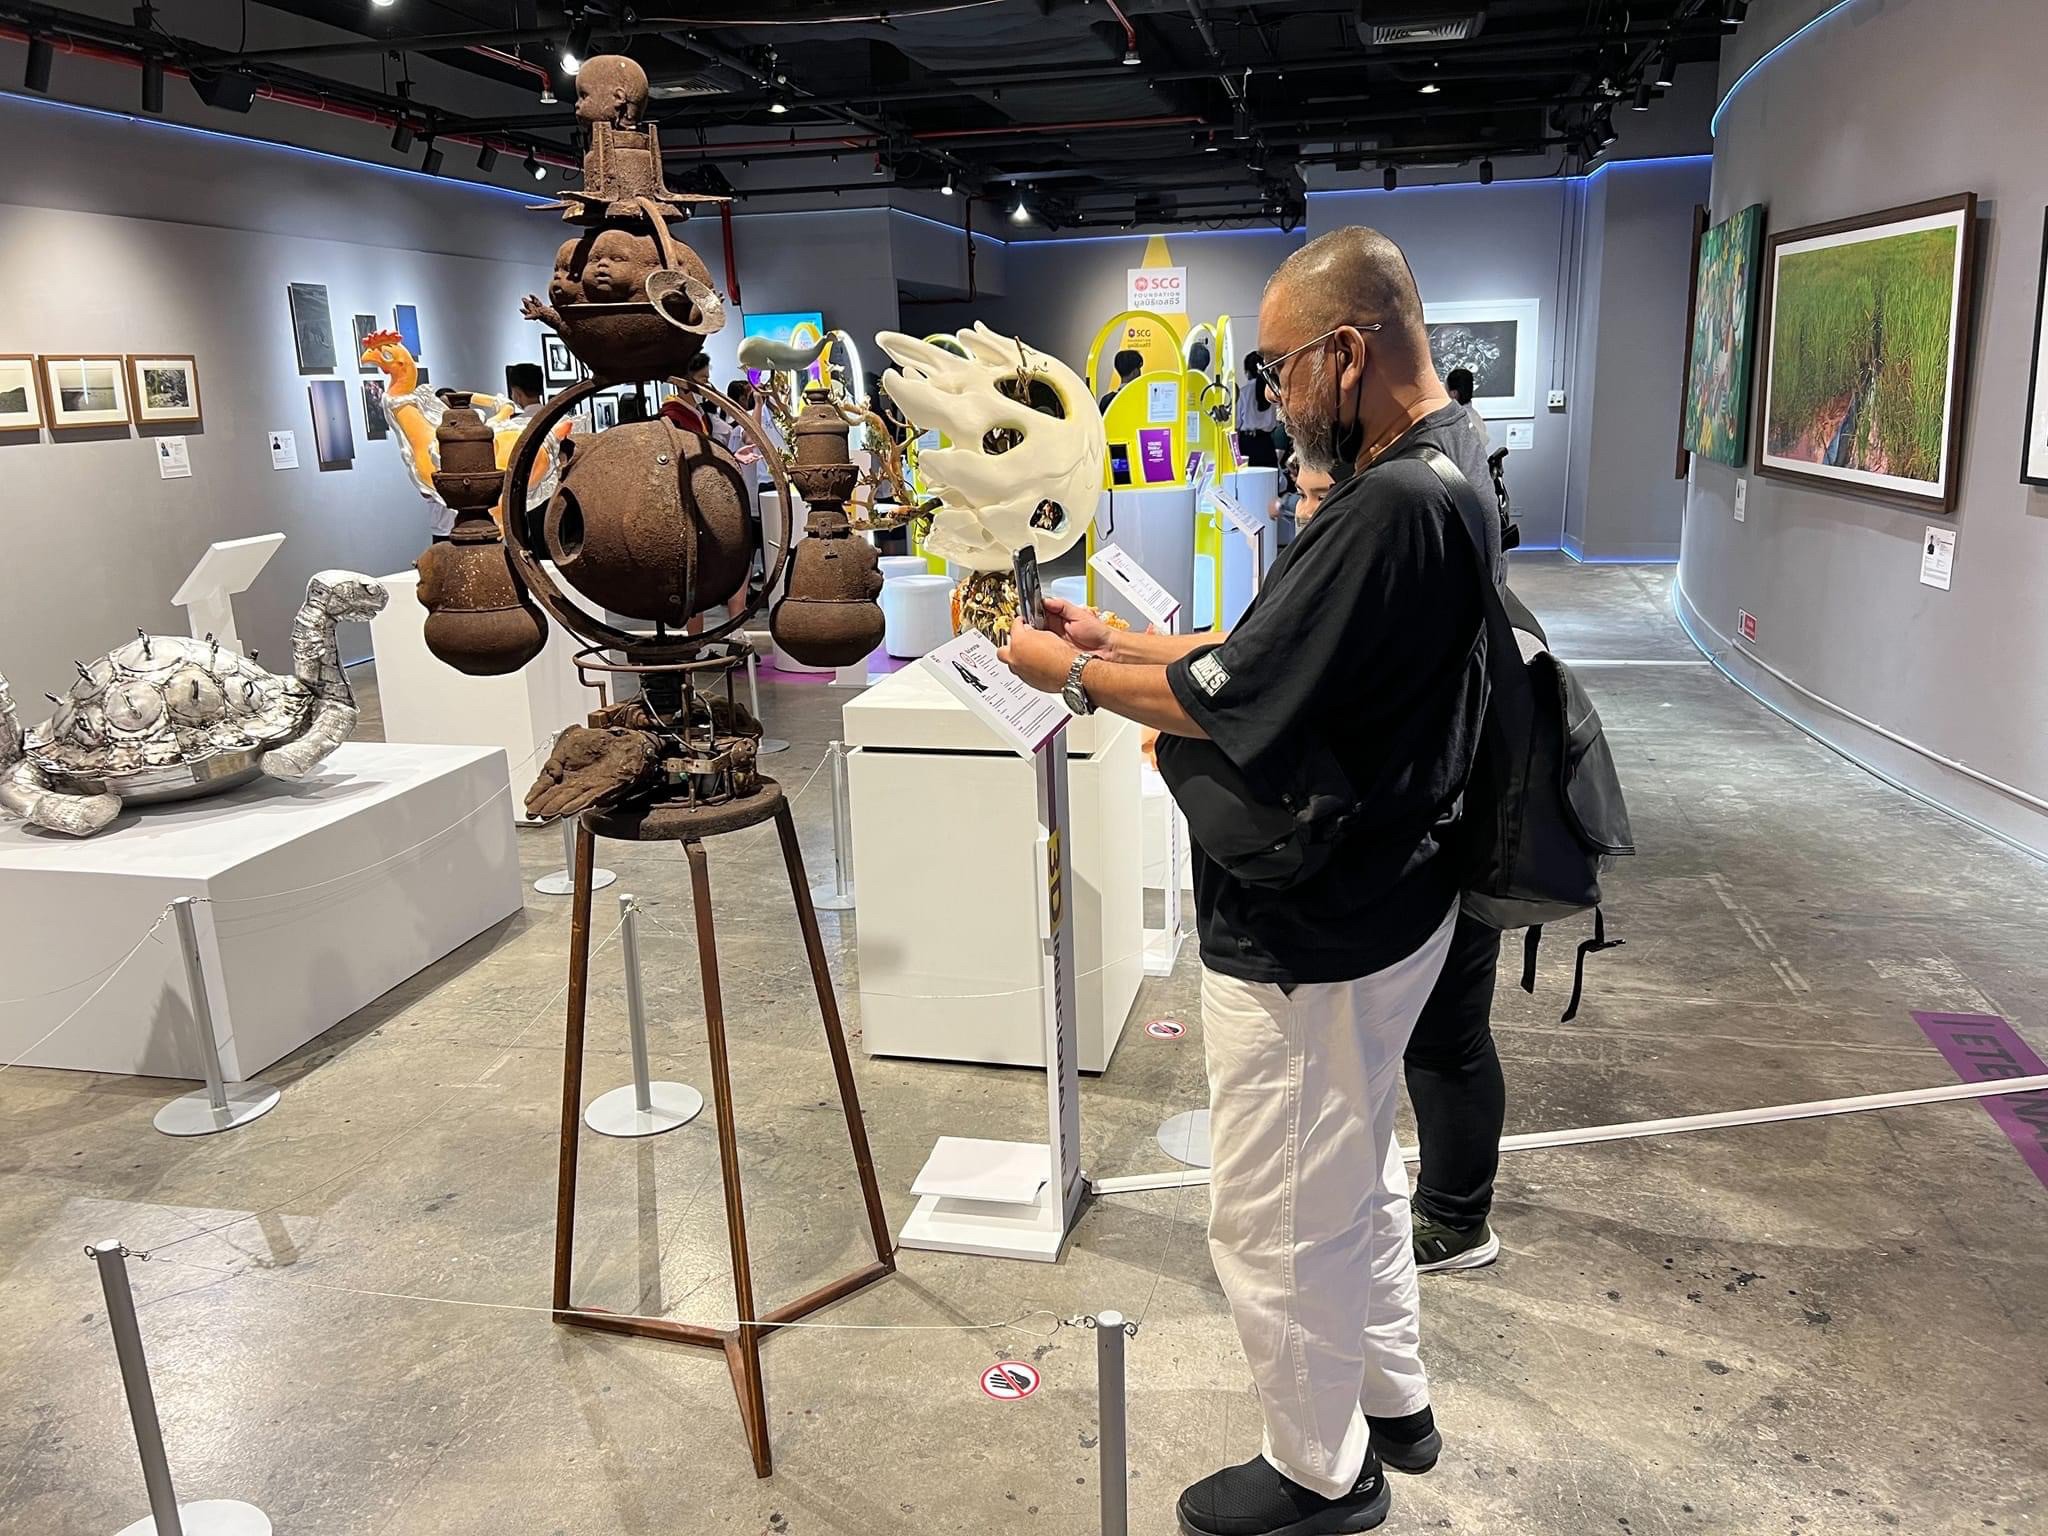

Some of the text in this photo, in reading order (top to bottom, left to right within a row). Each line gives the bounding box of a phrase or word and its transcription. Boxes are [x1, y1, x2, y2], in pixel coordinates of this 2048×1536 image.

[1151, 277, 1180, 290] SCG
[1134, 291, 1180, 299] FOUNDATION
[1136, 329, 1151, 338] SCG
